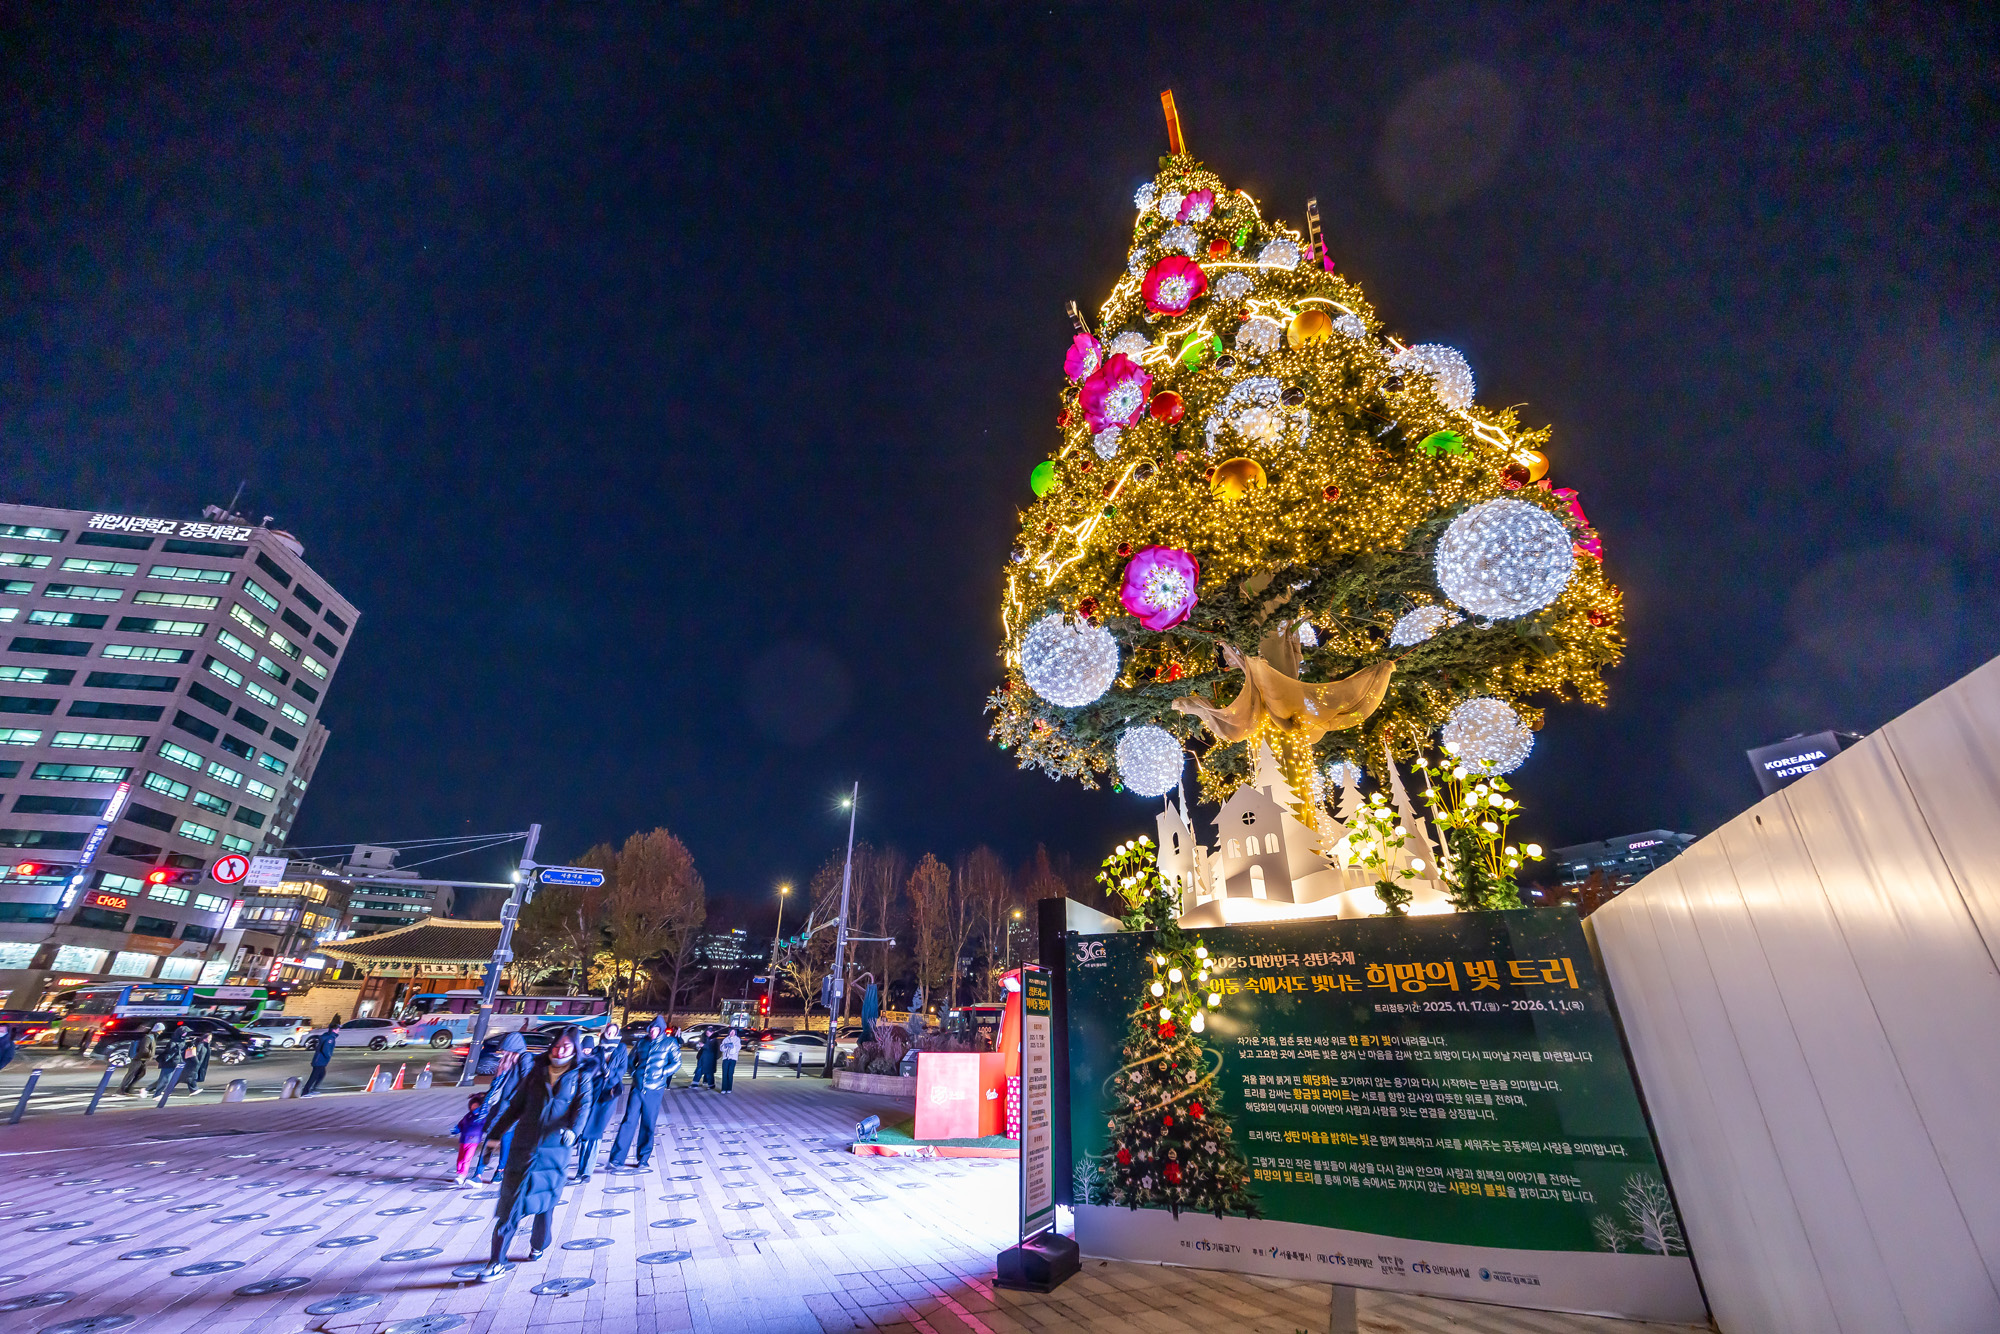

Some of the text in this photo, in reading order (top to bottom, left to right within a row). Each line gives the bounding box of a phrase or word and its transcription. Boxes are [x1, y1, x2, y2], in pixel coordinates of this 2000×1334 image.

[87, 513, 253, 542] 취업사관학교 경동대학교
[1763, 750, 1827, 770] KOREANA
[1776, 763, 1820, 778] HOTEL
[96, 894, 127, 909] 다이소
[1249, 953, 1300, 969] 대한민국
[1302, 951, 1356, 967] 성탄축제
[1209, 957, 1579, 995] 어둠 속에서도 빛나는 희망의 빛 트리
[1422, 1001, 1456, 1012] 2025.
[1457, 1001, 1470, 1012] 11.
[1511, 1000, 1548, 1012] 2026.
[1548, 1000, 1558, 1011] 1.
[1237, 1035, 1448, 1047] 차가운 겨울, 멈춘 듯한 세상 위로 한 줄기 빛이 내려옵니다.
[1238, 1050, 1593, 1063] 낮고 고요한 곳에 스며든 빛은 상처 난 마음을 감싸 안고 희망이 다시 피어날 자리를 마련합니다
[1242, 1074, 1563, 1092] 겨울 끝에 붉게 핀 해당화는 포기하지 않는 용기와 다시 시작하는 믿음을 의미합니다.
[1243, 1088, 1528, 1107] 트리를 감싸는 황금빛 라이트는 서로를 향한 감사와 따뜻한 위로를 전하며,
[1245, 1102, 1498, 1121] 해당화의 에너지를 이어받아 사람과 사람을 잇는 연결을 상징합니다.
[1248, 1130, 1628, 1157] 트리 하단, 성탄 마을을 밝히는 빛은 함께 회복하고 서로를 세워주는 공동체의 사랑을 의미합니다.
[1252, 1157, 1581, 1188] 그렇게 모인 작은 불빛들이 세상을 다시 감싸 안으며 사랑과 회복의 이야기를 전하는
[1253, 1169, 1597, 1204] 희망의 빛 트리를 통해 어둠 속에서도 꺼지지 않는 사랑의 불빛을 밝히고자 합니다.
[1195, 1240, 1211, 1251] CTS
[1211, 1242, 1241, 1254] 기독교TV
[1412, 1262, 1432, 1274] CTS
[1432, 1265, 1471, 1278] 인터내셔널
